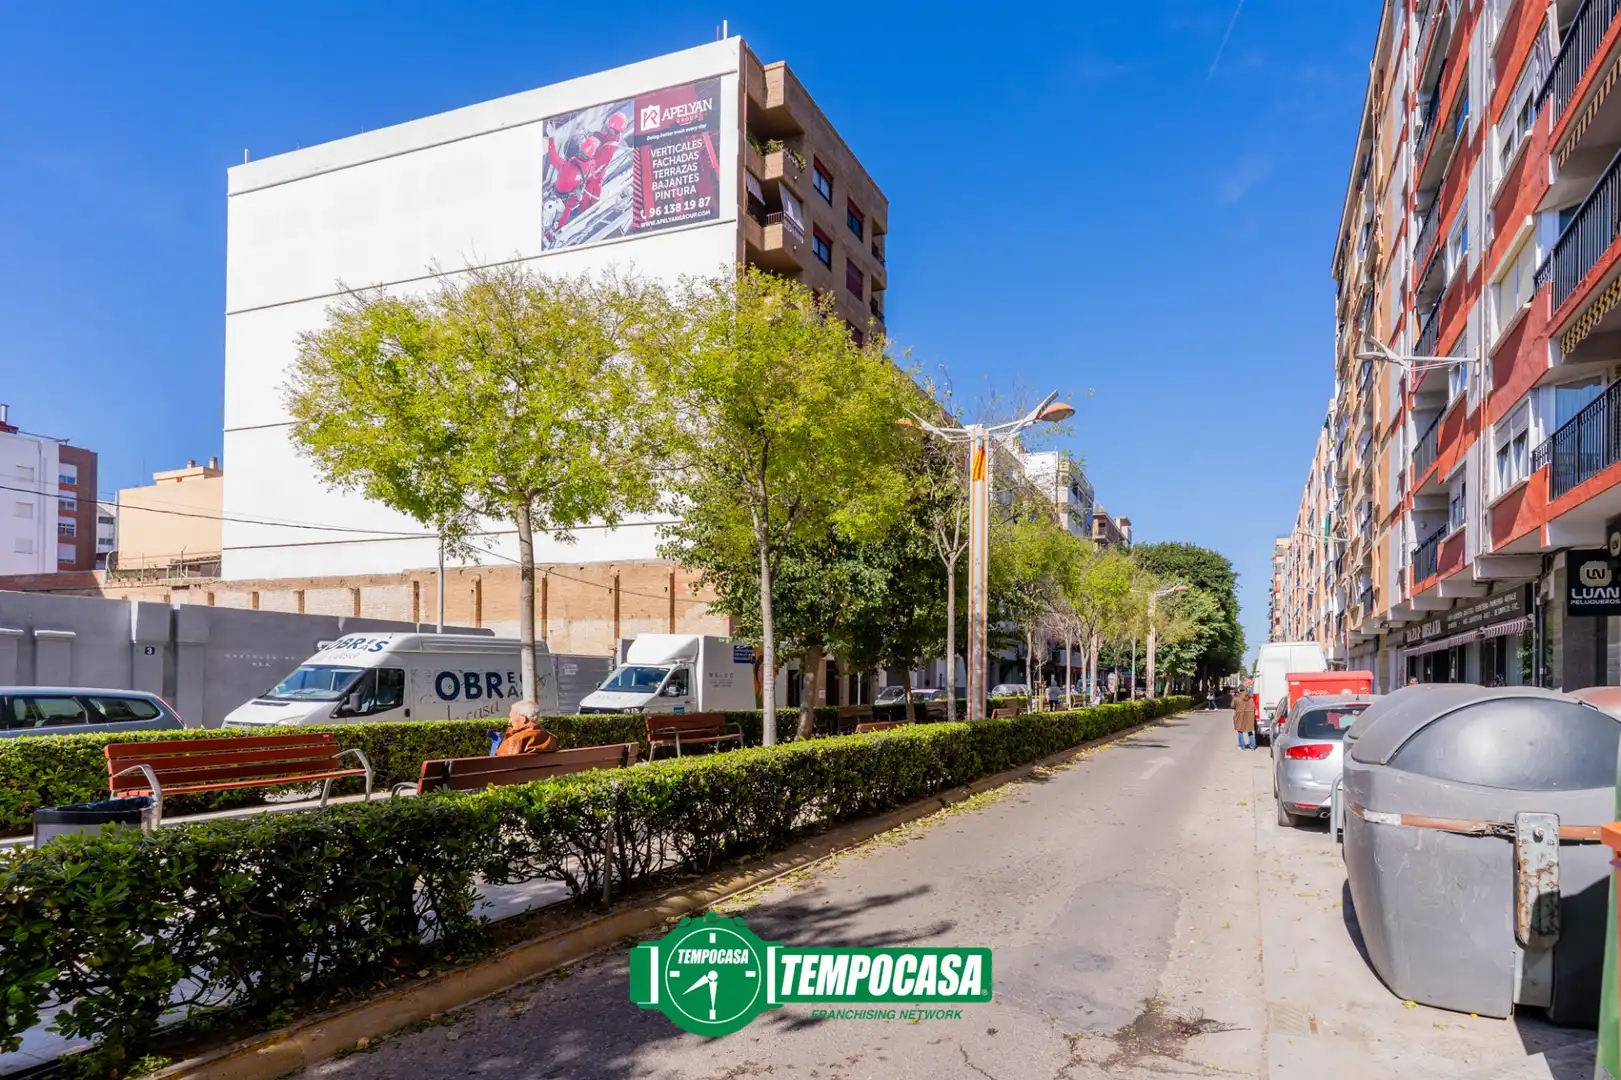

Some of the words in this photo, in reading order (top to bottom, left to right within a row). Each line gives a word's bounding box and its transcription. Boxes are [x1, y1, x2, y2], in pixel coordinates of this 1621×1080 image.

[661, 98, 713, 121] APELYAN
[651, 139, 703, 158] VERTICALES
[652, 151, 700, 169] FACHADAS
[653, 163, 698, 179] TERRAZAS
[652, 173, 700, 191] BAJANTES
[655, 185, 696, 200] PINTURA
[649, 207, 662, 217] 96
[664, 203, 682, 215] 138
[684, 200, 696, 211] 19
[698, 196, 711, 208] 87
[1571, 587, 1620, 599] LUAN
